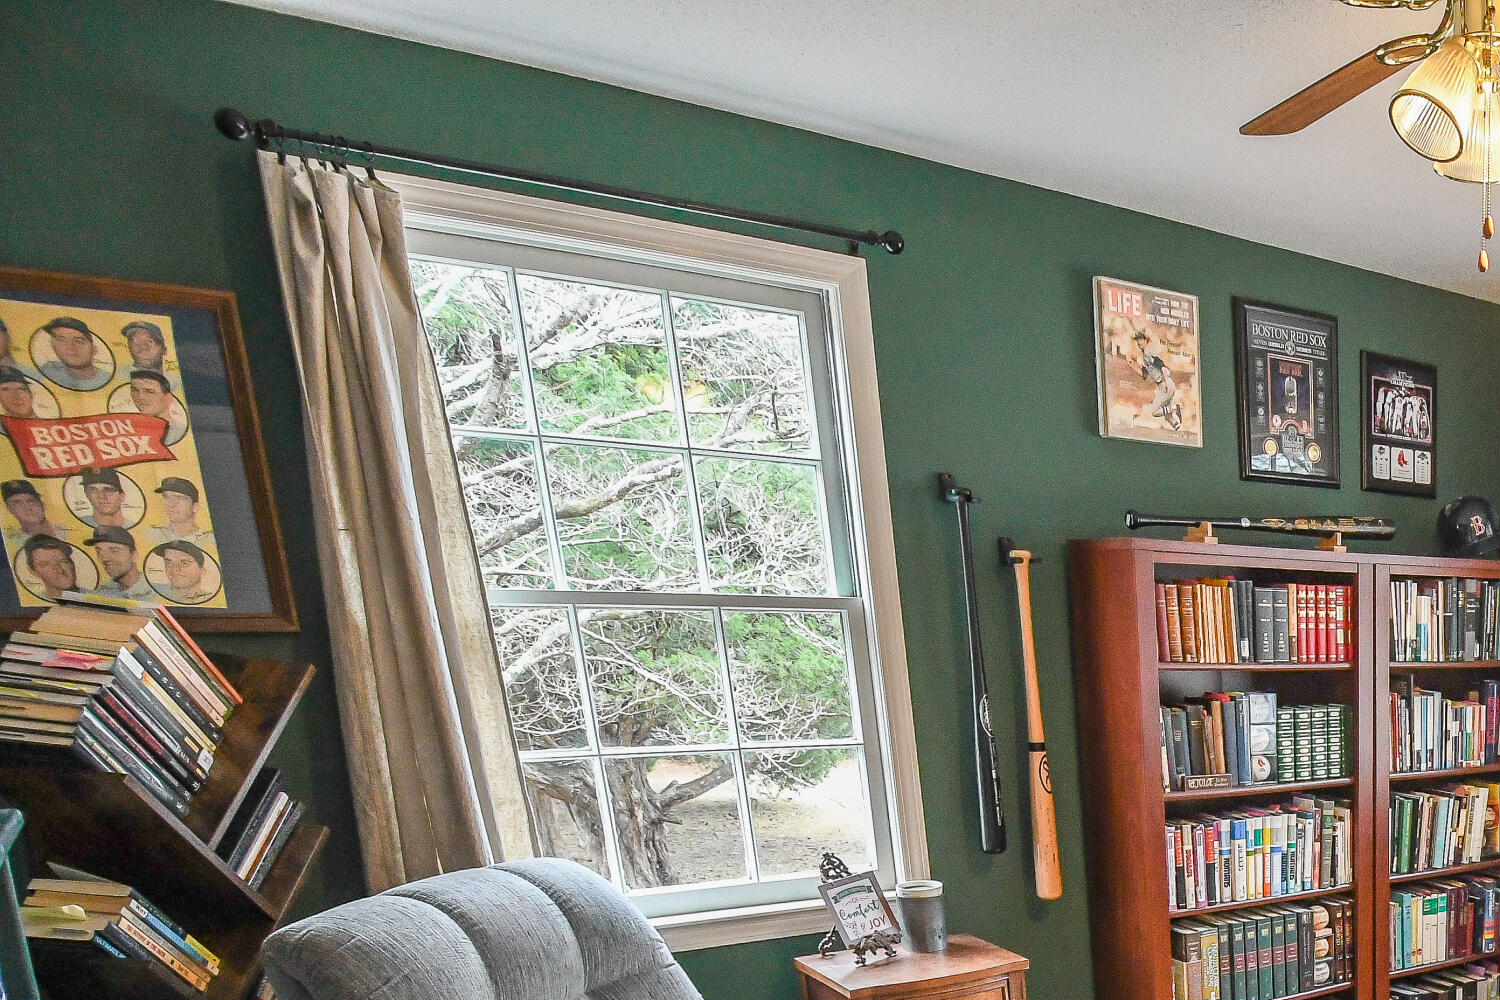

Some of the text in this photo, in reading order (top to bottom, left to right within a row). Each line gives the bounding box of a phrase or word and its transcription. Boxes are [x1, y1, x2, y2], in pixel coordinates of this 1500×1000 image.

[1107, 290, 1141, 316] LIFE
[1252, 323, 1327, 348] BOSTON RED SOX
[29, 419, 136, 445] BOSTON
[28, 435, 158, 471] RED SOX
[1188, 777, 1214, 789] REJOICE
[1223, 857, 1231, 888] ROMANS
[839, 899, 880, 920] Comfort
[869, 915, 886, 930] JOY
